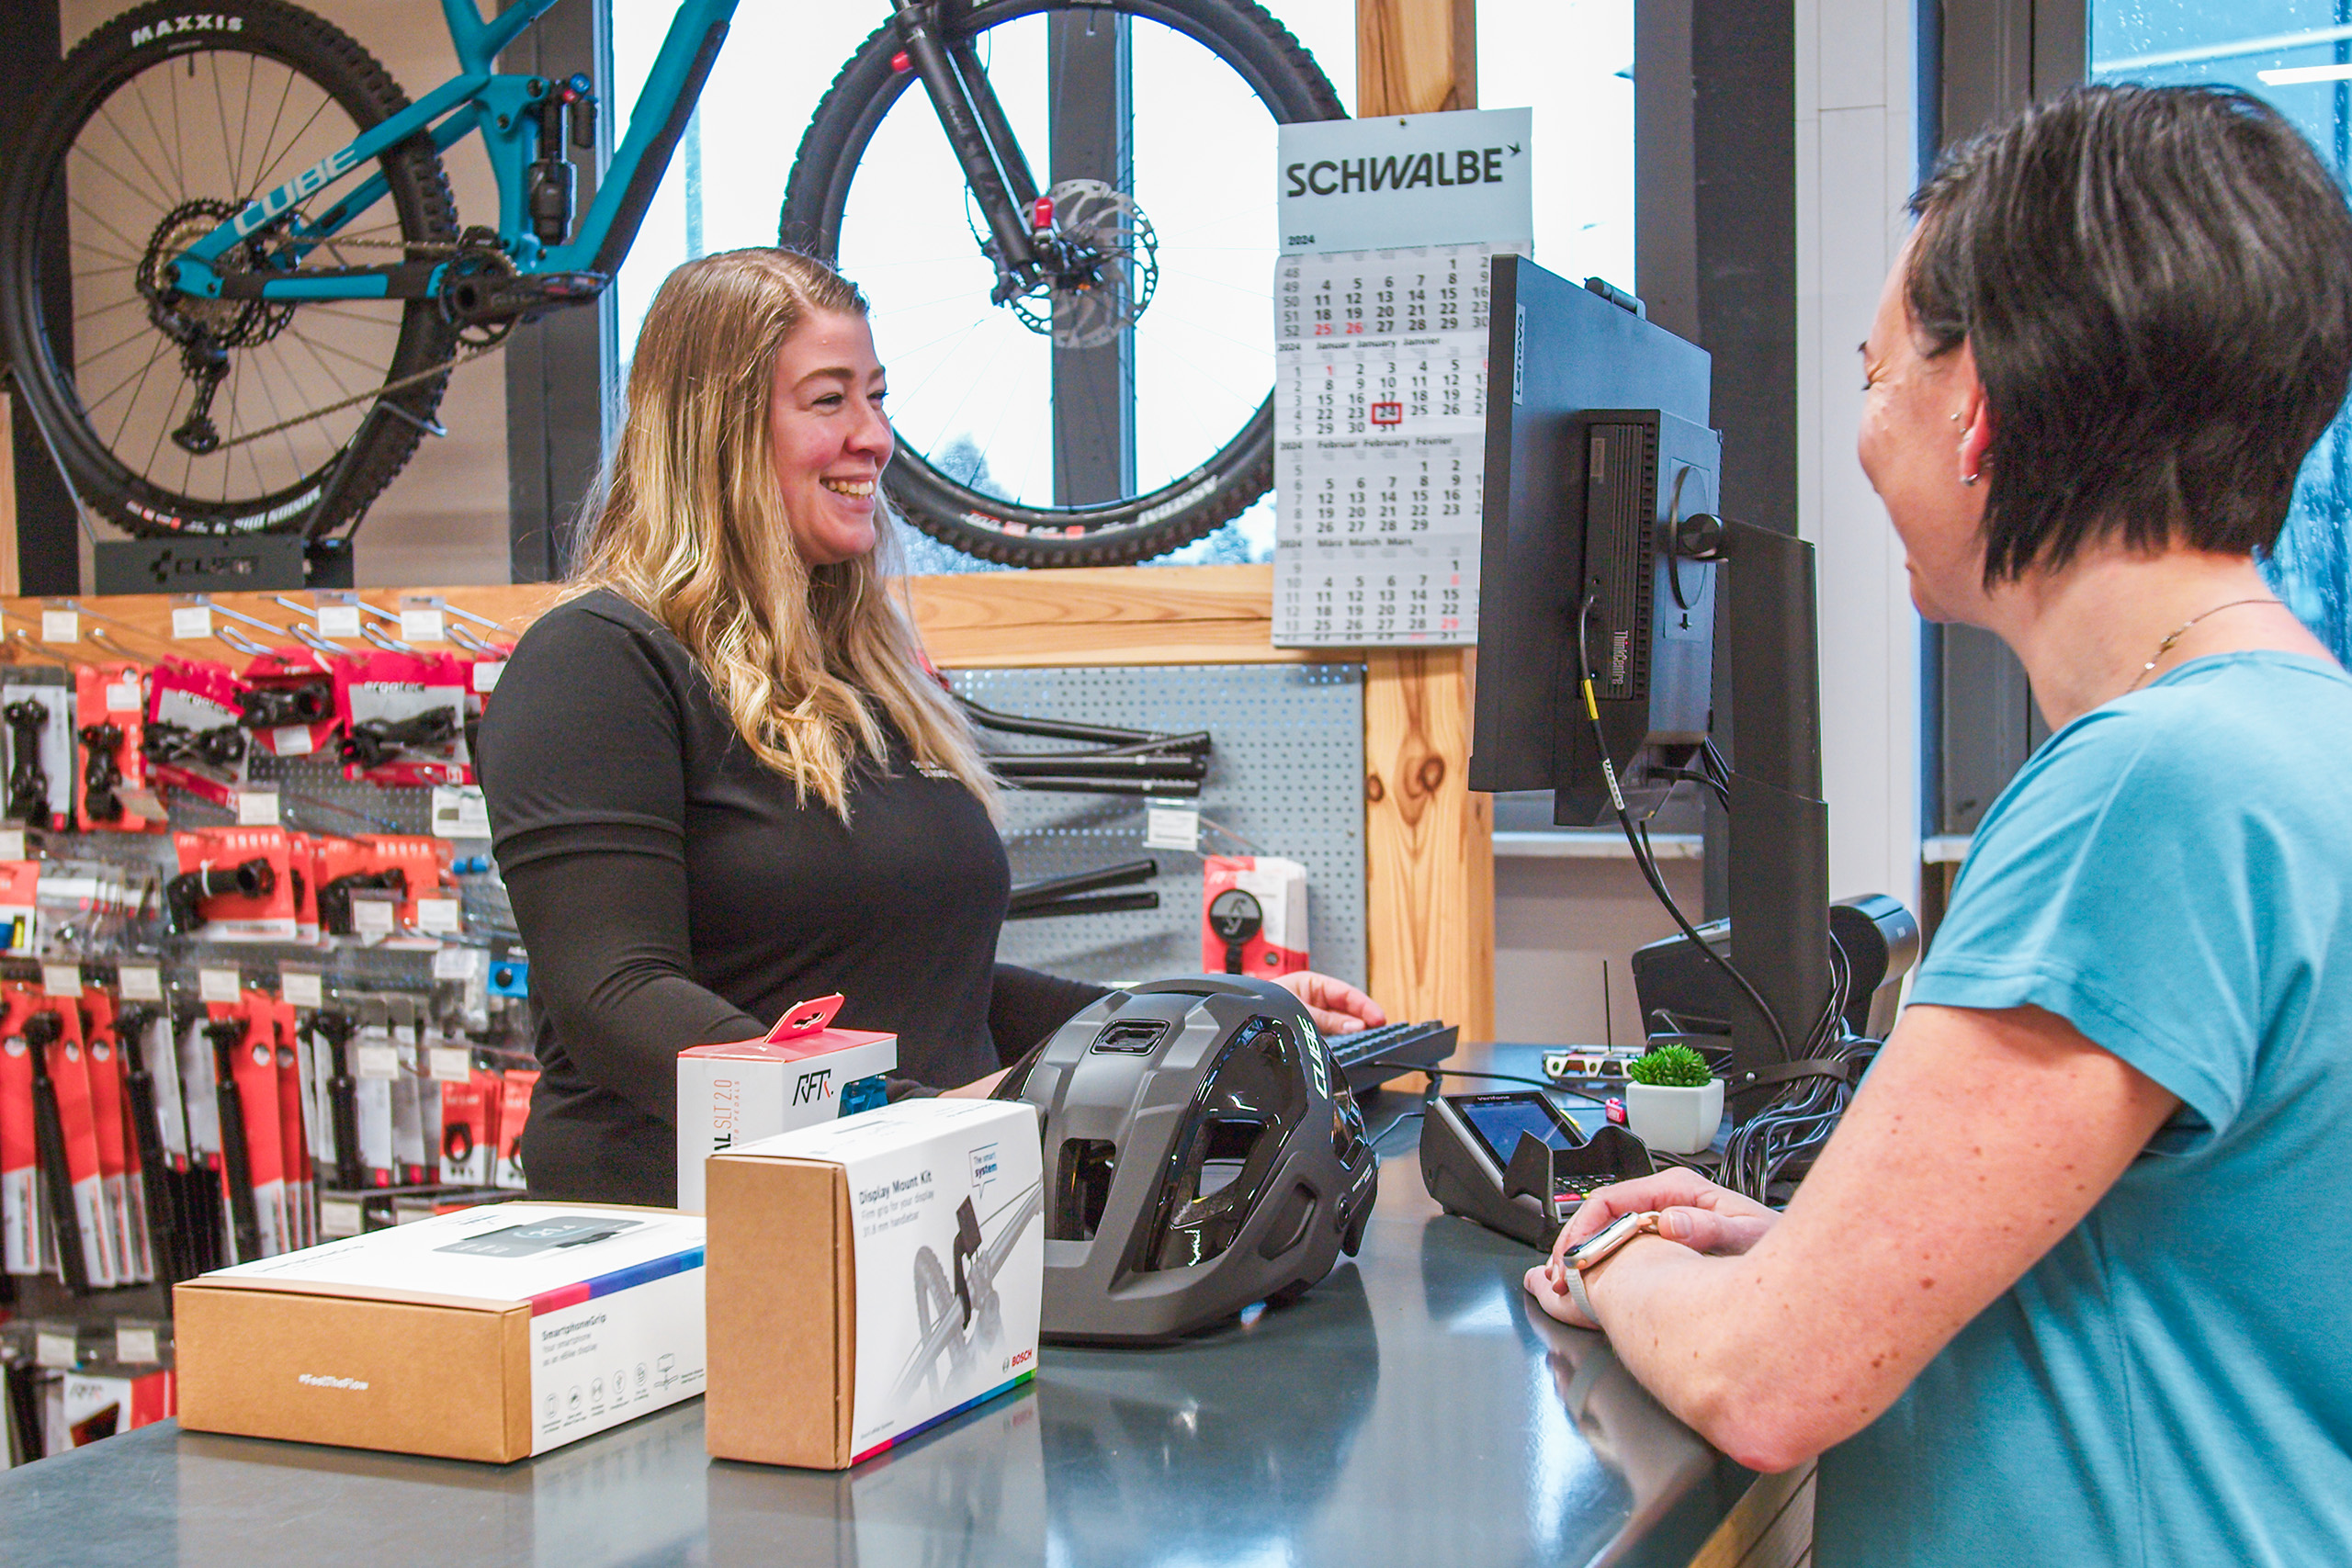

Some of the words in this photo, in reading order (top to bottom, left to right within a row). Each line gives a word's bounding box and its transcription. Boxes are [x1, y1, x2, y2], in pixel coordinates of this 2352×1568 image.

[130, 14, 243, 49] MAXXIS
[1286, 148, 1503, 197] SCHWALBE
[233, 143, 358, 237] CUBE
[1288, 235, 1315, 245] 2024
[1450, 259, 1455, 269] 1
[1322, 280, 1330, 290] 4
[1354, 278, 1362, 289] 5
[1385, 276, 1394, 288] 6
[1418, 275, 1425, 286] 7
[1449, 274, 1456, 284] 8
[1480, 271, 1488, 283] 9
[1315, 295, 1330, 306] 11
[1346, 293, 1362, 304] 12
[1377, 291, 1393, 302] 13
[1408, 289, 1425, 300] 14
[1441, 288, 1457, 299] 15
[1472, 286, 1488, 298] 16
[1316, 309, 1331, 320] 18
[1346, 308, 1363, 319] 19
[1377, 306, 1394, 317] 20
[1408, 305, 1424, 316] 21
[1441, 303, 1456, 314] 22
[1472, 301, 1490, 314] 23
[1316, 324, 1332, 335] 25
[1346, 322, 1363, 333] 26
[1377, 321, 1394, 333] 27
[1409, 320, 1426, 331] 28
[1441, 318, 1458, 329] 29
[1474, 315, 1490, 330] 30
[1515, 313, 1523, 396] Lenovo
[1327, 366, 1332, 375] 1
[1357, 364, 1363, 375] 2
[1389, 362, 1396, 373] 3
[1419, 361, 1427, 371] 4
[1452, 359, 1459, 370] 5
[1326, 379, 1333, 390] 8
[1357, 378, 1364, 389] 9
[1381, 377, 1396, 388] 10
[1412, 376, 1426, 386] 11
[1443, 374, 1459, 385] 12
[1317, 394, 1333, 405] 15
[1350, 393, 1364, 404] 16
[1413, 390, 1428, 400] 18
[1443, 389, 1460, 400] 19
[1317, 409, 1332, 420] 22
[1349, 407, 1364, 419] 23
[1377, 405, 1398, 417] 24
[1411, 405, 1428, 415] 25
[1443, 403, 1460, 415] 26
[1317, 423, 1333, 434] 29
[1349, 422, 1365, 434] 30
[1281, 442, 1303, 450] 2024
[1363, 439, 1408, 447] February
[1421, 461, 1427, 471] 1
[1453, 460, 1460, 470] 2
[1326, 479, 1334, 490] 5
[1357, 478, 1365, 488] 6
[1389, 477, 1396, 487] 7
[1420, 476, 1428, 486] 8
[1452, 475, 1460, 485] 9
[1318, 493, 1333, 504] 12
[1350, 492, 1364, 502] 13
[1381, 491, 1396, 502] 14
[1412, 491, 1428, 502] 15
[1444, 490, 1461, 500] 16
[1318, 508, 1334, 518] 19
[1349, 507, 1365, 518] 20
[1380, 506, 1396, 517] 21
[1411, 505, 1428, 516] 22
[1443, 504, 1460, 515] 23
[1317, 522, 1334, 533] 26
[1349, 521, 1364, 532] 27
[1380, 521, 1396, 532] 28
[1411, 519, 1428, 531] 29
[1280, 540, 1302, 548] 2024
[1453, 560, 1458, 570] 1
[1325, 578, 1332, 587] 4
[1356, 576, 1364, 587] 5
[1387, 576, 1396, 586] 6
[1420, 575, 1427, 585] 7
[1317, 592, 1331, 602] 11
[1349, 591, 1363, 602] 12
[1380, 590, 1395, 601] 13
[1411, 590, 1427, 600] 14
[1443, 589, 1459, 600] 15
[1317, 606, 1331, 616] 18
[1348, 605, 1363, 615] 19
[1378, 604, 1396, 615] 20
[1409, 604, 1425, 615] 21
[1442, 604, 1458, 615] 22
[1315, 620, 1331, 631] 25
[1346, 620, 1363, 630] 26
[1377, 619, 1394, 630] 27
[1409, 618, 1426, 629] 28
[1442, 618, 1458, 629] 29
[1611, 630, 1629, 685] ThinkCentre
[363, 681, 425, 694] ergotec
[177, 688, 231, 716] ergotec
[1295, 1014, 1328, 1100] CUBE
[713, 1079, 732, 1100] 2.0
[713, 1105, 732, 1129] SLT
[975, 1163, 998, 1179] system
[859, 1185, 889, 1205] Display
[892, 1176, 919, 1192] Mount
[921, 1169, 933, 1184] Kit
[542, 1314, 606, 1340] SmartphoneGrip
[1011, 1348, 1033, 1367] BOSCH
